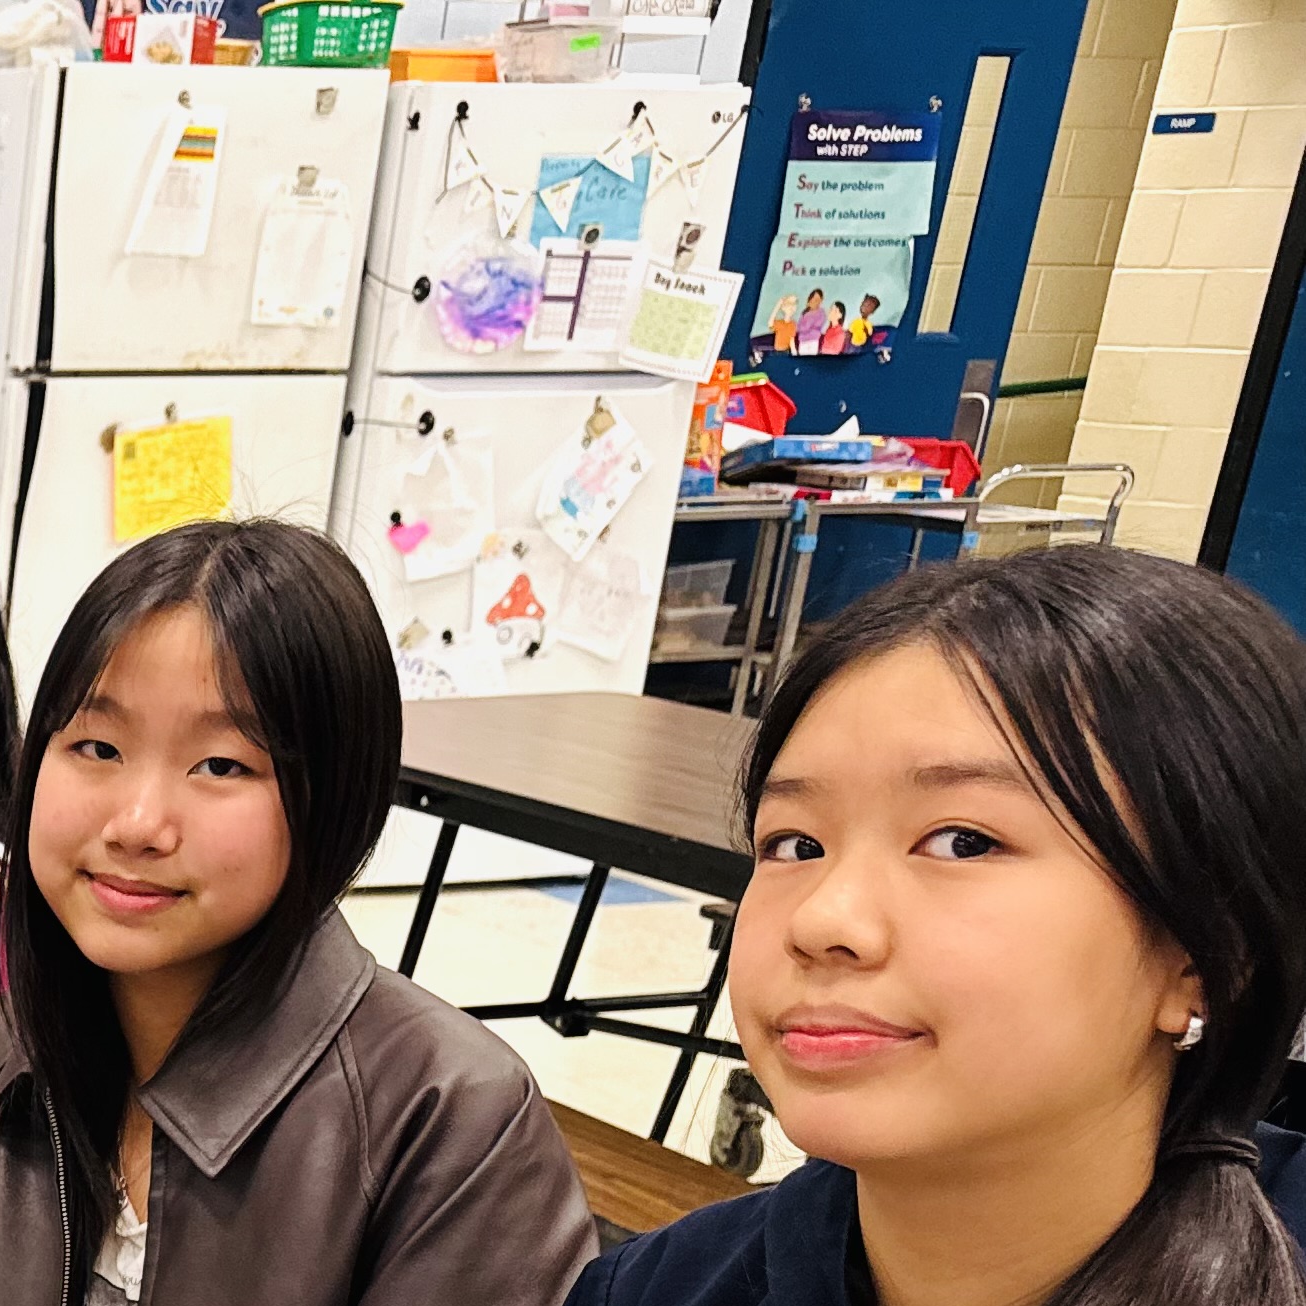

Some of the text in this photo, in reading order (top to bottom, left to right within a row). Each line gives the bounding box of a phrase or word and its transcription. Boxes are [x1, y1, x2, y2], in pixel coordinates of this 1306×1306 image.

[807, 123, 923, 143] Solve Problems
[816, 143, 869, 157] with STEP
[796, 173, 884, 193] Say the problem
[794, 203, 886, 220] Think of solutions
[787, 232, 907, 250] Explore the outcomes
[782, 260, 861, 277] Pick a solution
